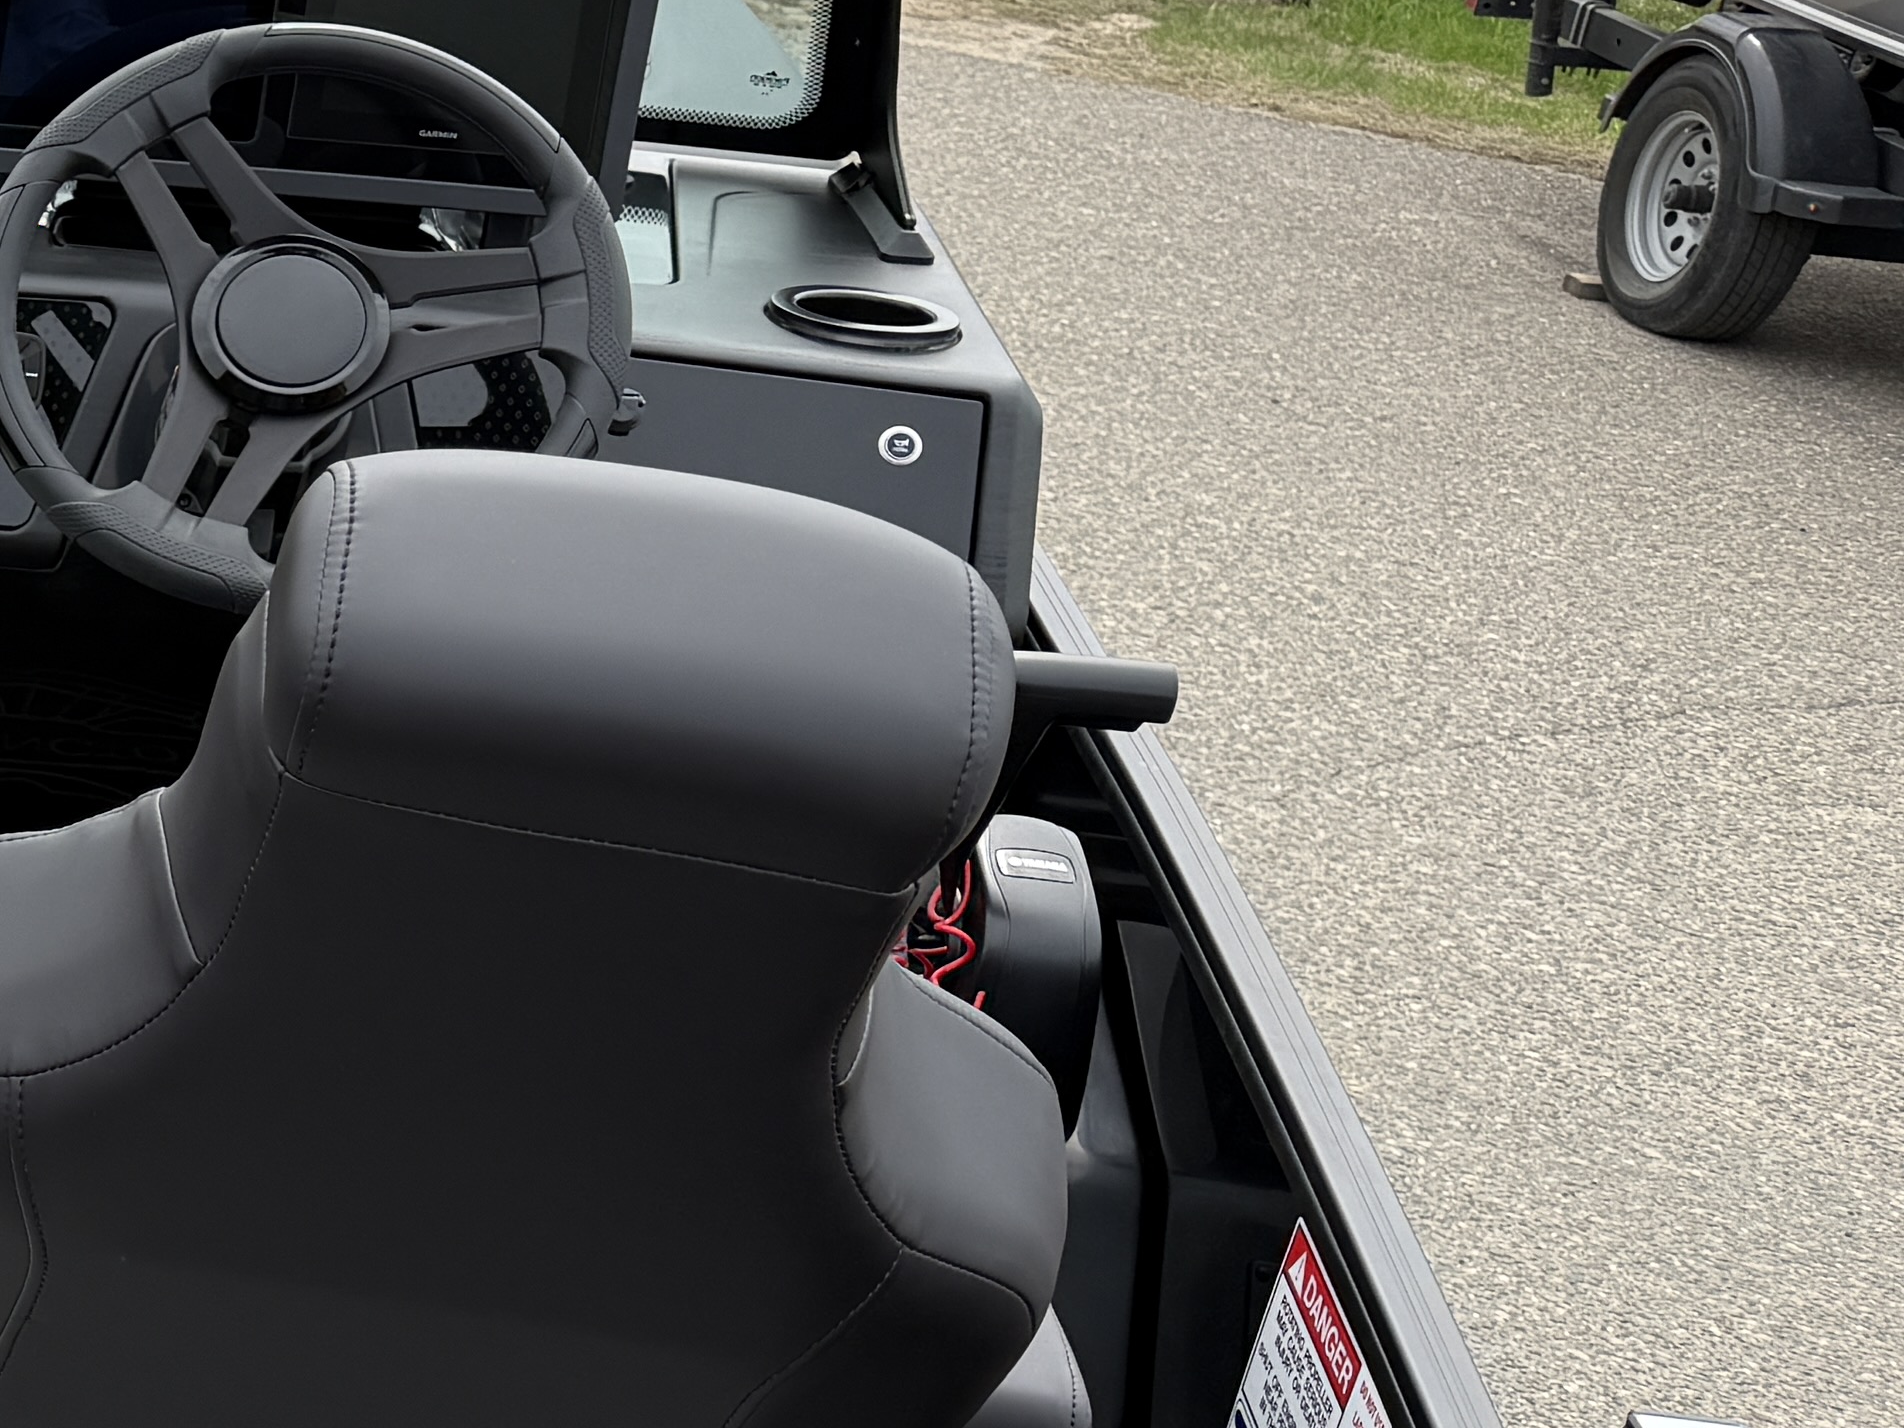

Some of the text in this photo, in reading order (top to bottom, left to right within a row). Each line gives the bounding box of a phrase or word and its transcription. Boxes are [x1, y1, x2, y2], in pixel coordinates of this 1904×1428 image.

[1276, 1310, 1288, 1336] MAY
[1287, 1336, 1305, 1378] CAUSE
[1280, 1294, 1332, 1418] ROTATING PROPELLER
[1303, 1275, 1352, 1392] DANGER
[1263, 1379, 1277, 1415] NEAR
[1272, 1374, 1283, 1397] OFF
[1292, 1376, 1301, 1399] OR
